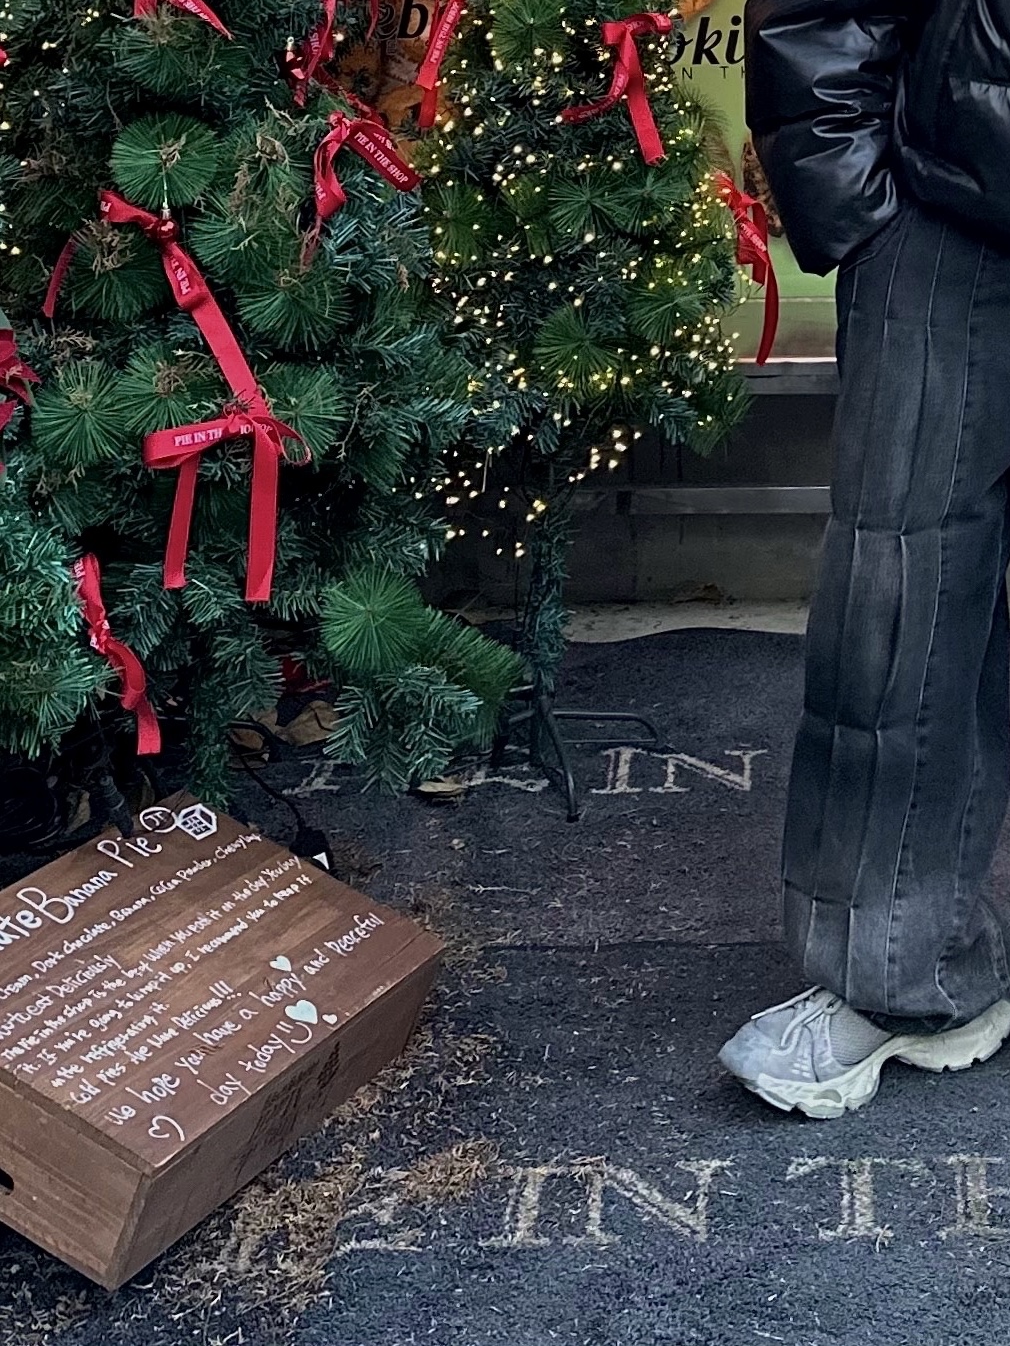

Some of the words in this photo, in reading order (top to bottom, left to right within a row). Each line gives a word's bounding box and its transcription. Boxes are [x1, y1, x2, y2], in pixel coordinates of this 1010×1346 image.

[373, 150, 392, 168] THE
[386, 165, 409, 184] SHOP
[174, 435, 192, 447] PIE
[194, 431, 206, 442] IN
[592, 747, 768, 794] IN
[16, 869, 118, 925] Banana
[96, 836, 163, 868] Pie
[31, 951, 66, 973] Dark
[303, 948, 331, 976] and
[248, 972, 308, 1008] happy
[239, 1008, 259, 1020] a
[192, 1019, 243, 1047] have
[124, 1072, 180, 1104] hope
[197, 1072, 252, 1106] day
